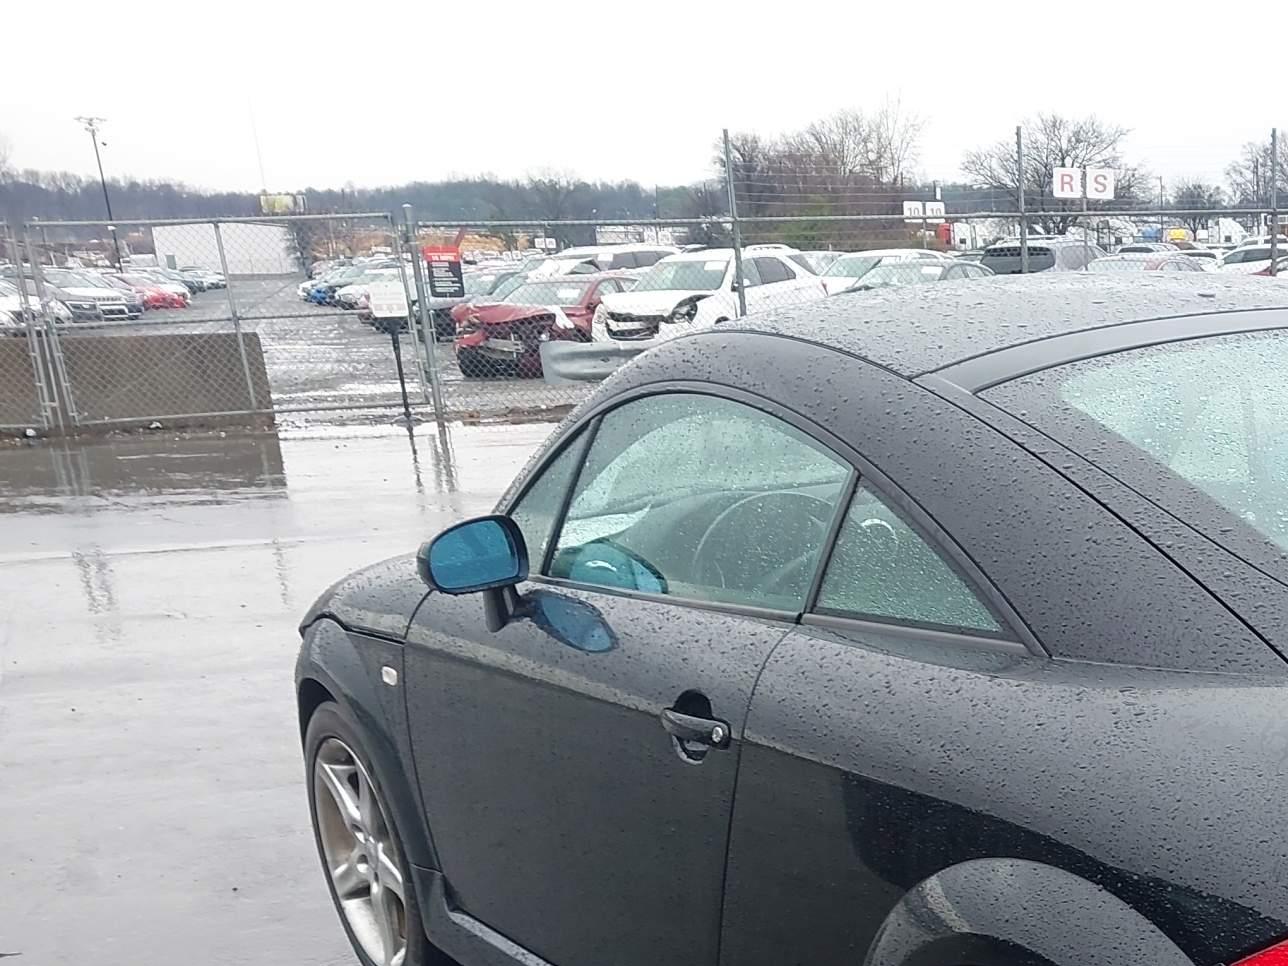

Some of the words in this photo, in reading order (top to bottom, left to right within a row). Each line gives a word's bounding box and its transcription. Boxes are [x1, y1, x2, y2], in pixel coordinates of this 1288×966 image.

[1060, 173, 1074, 192] R
[1094, 174, 1108, 193] S
[907, 207, 920, 217] 10
[930, 207, 942, 217] 10
